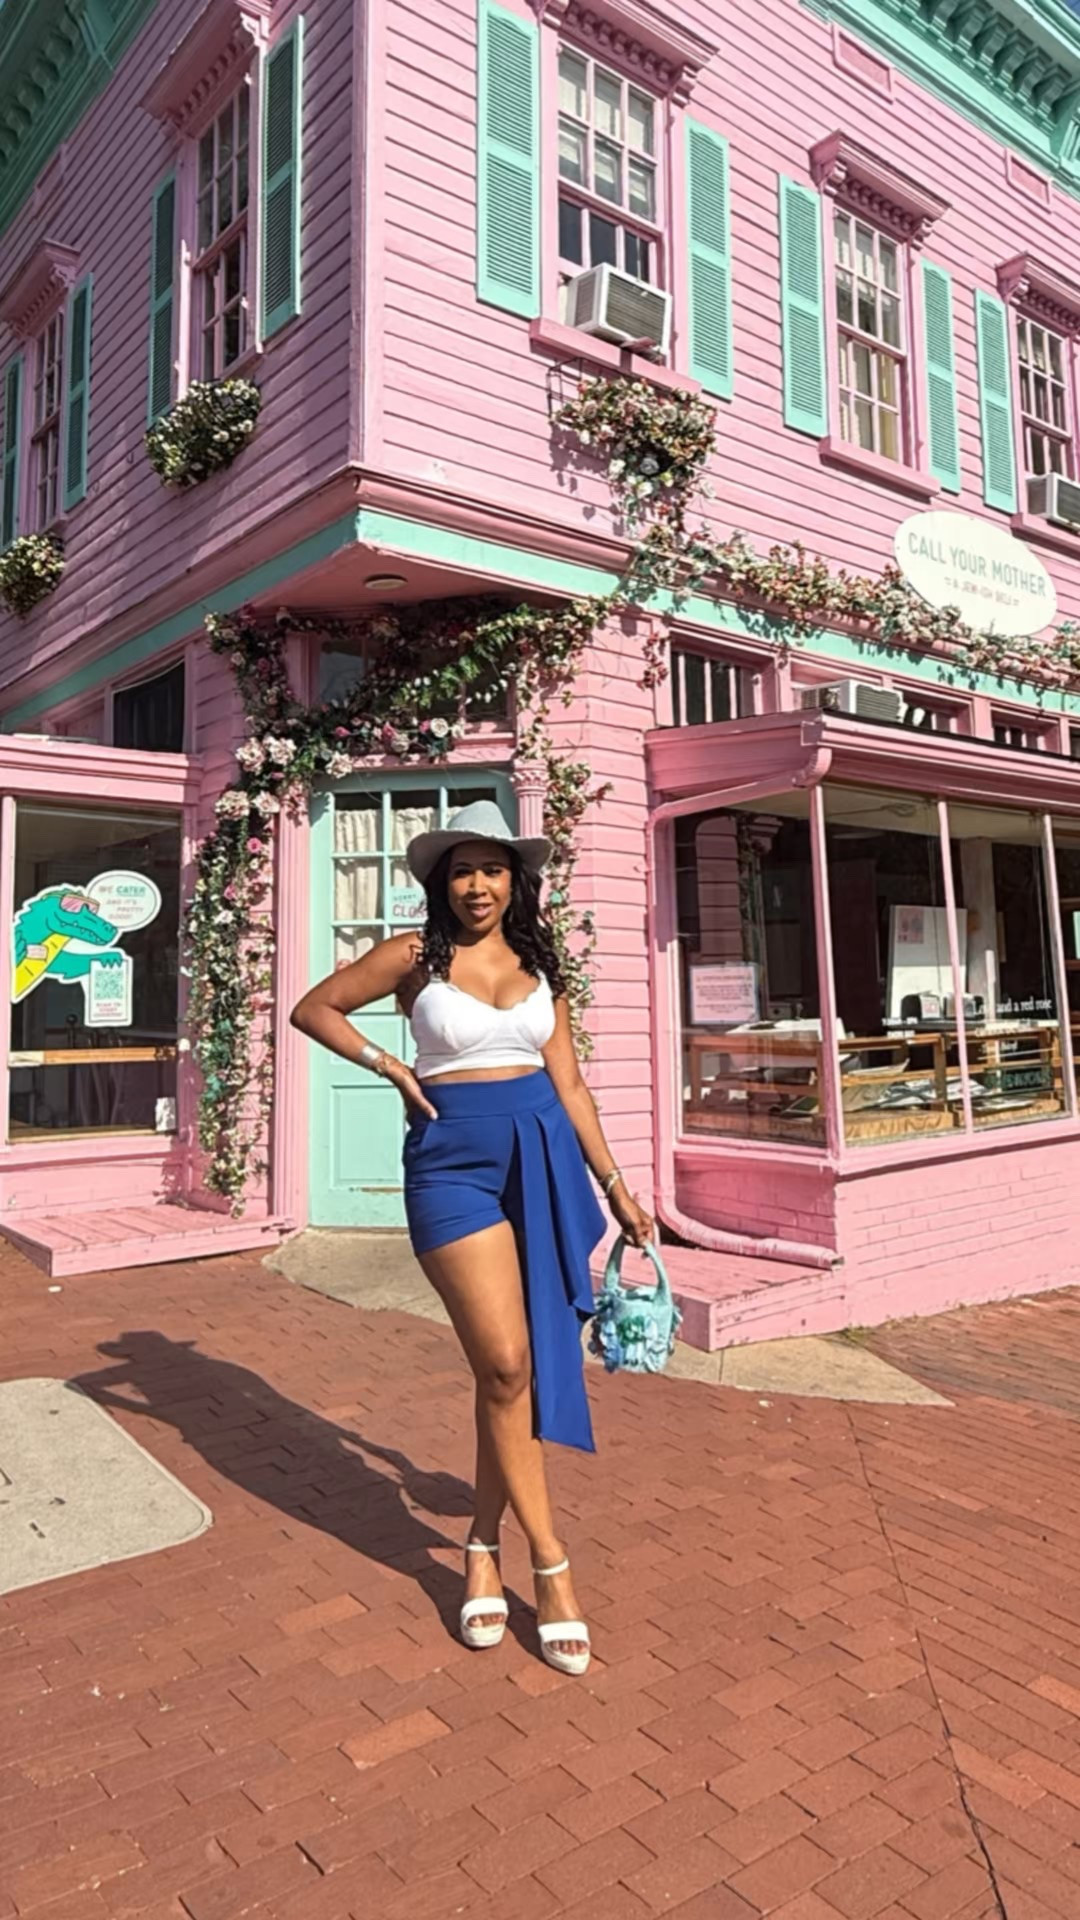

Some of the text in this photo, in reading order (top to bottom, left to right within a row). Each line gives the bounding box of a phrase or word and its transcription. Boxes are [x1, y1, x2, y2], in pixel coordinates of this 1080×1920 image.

[908, 532, 1046, 597] CALL YOUR MOTHER
[116, 885, 146, 895] CATER
[996, 997, 1012, 1013] and
[1013, 1001, 1019, 1012] a
[1020, 996, 1035, 1012] red
